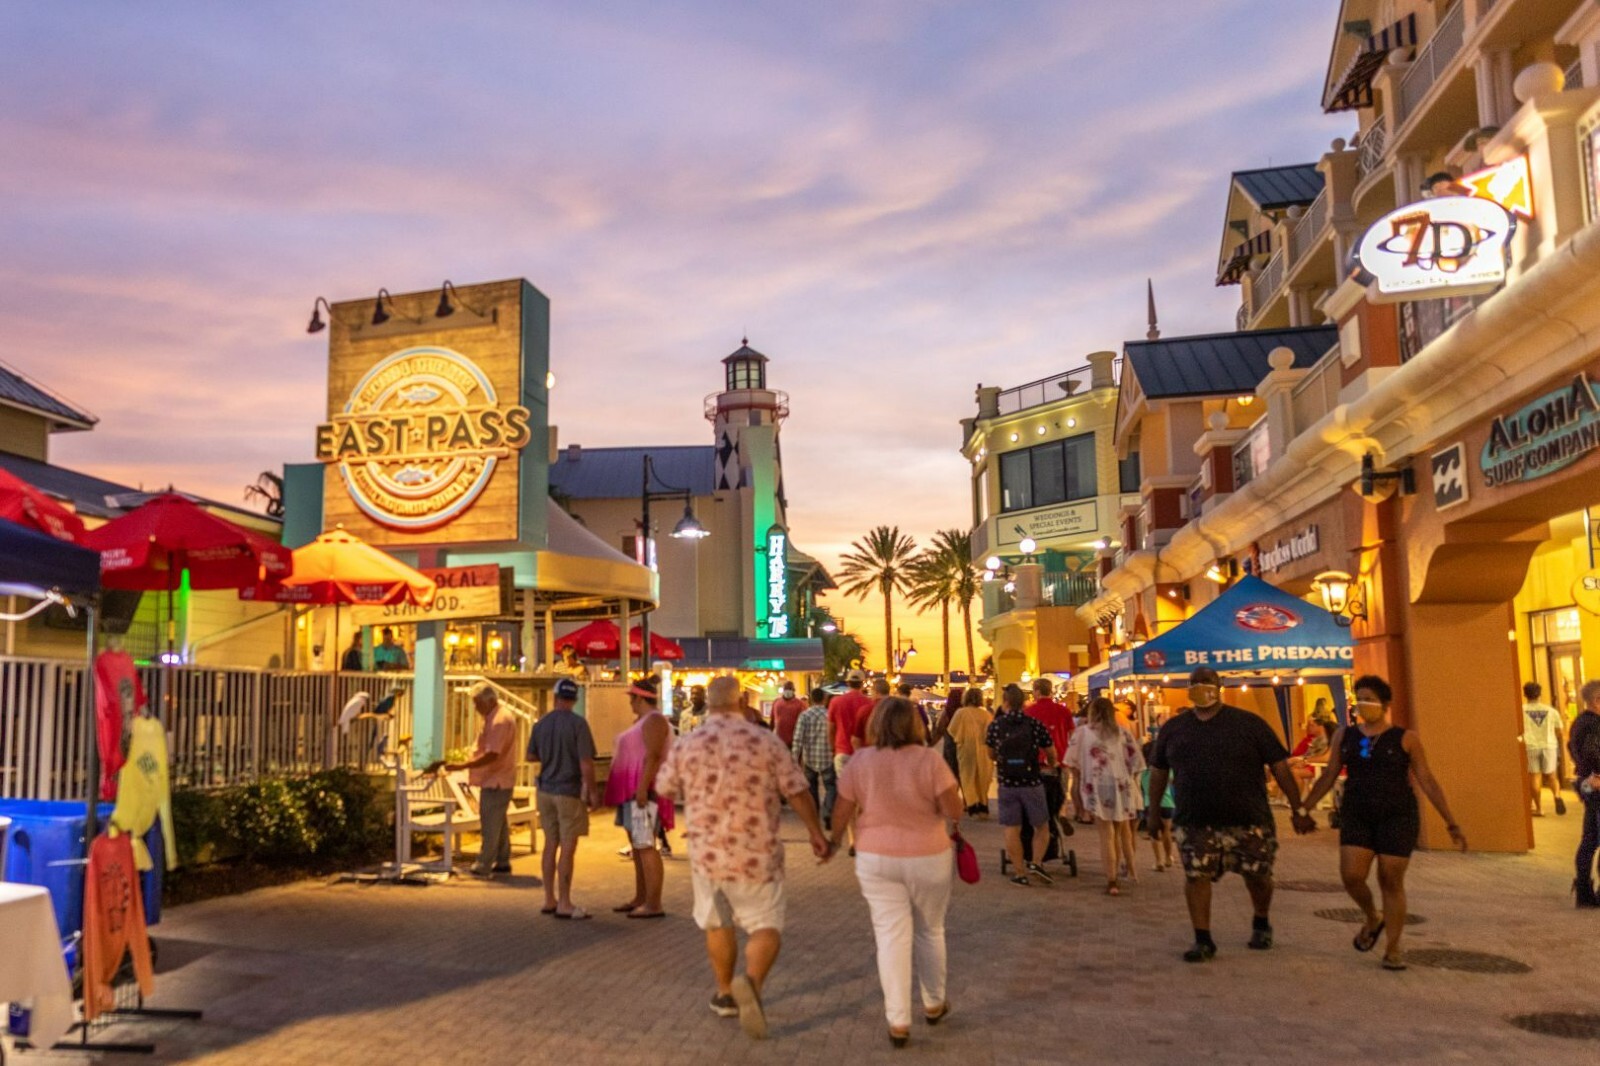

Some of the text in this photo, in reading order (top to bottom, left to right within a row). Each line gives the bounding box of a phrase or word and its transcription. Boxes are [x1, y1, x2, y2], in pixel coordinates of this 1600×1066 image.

[1391, 211, 1473, 268] 7D
[316, 406, 530, 459] EAST PASS
[1488, 372, 1600, 460] ALOHA
[1484, 420, 1600, 487] SURF COMPAN
[1029, 516, 1082, 530] SPECIAL EVENTS
[1033, 511, 1068, 521] WEDDINGS
[1290, 526, 1318, 560] World
[434, 571, 487, 589] OCAL.
[768, 535, 786, 613] HARRY
[1184, 650, 1208, 666] BE
[1212, 648, 1253, 664] THE
[1258, 645, 1354, 661] PREDATO
